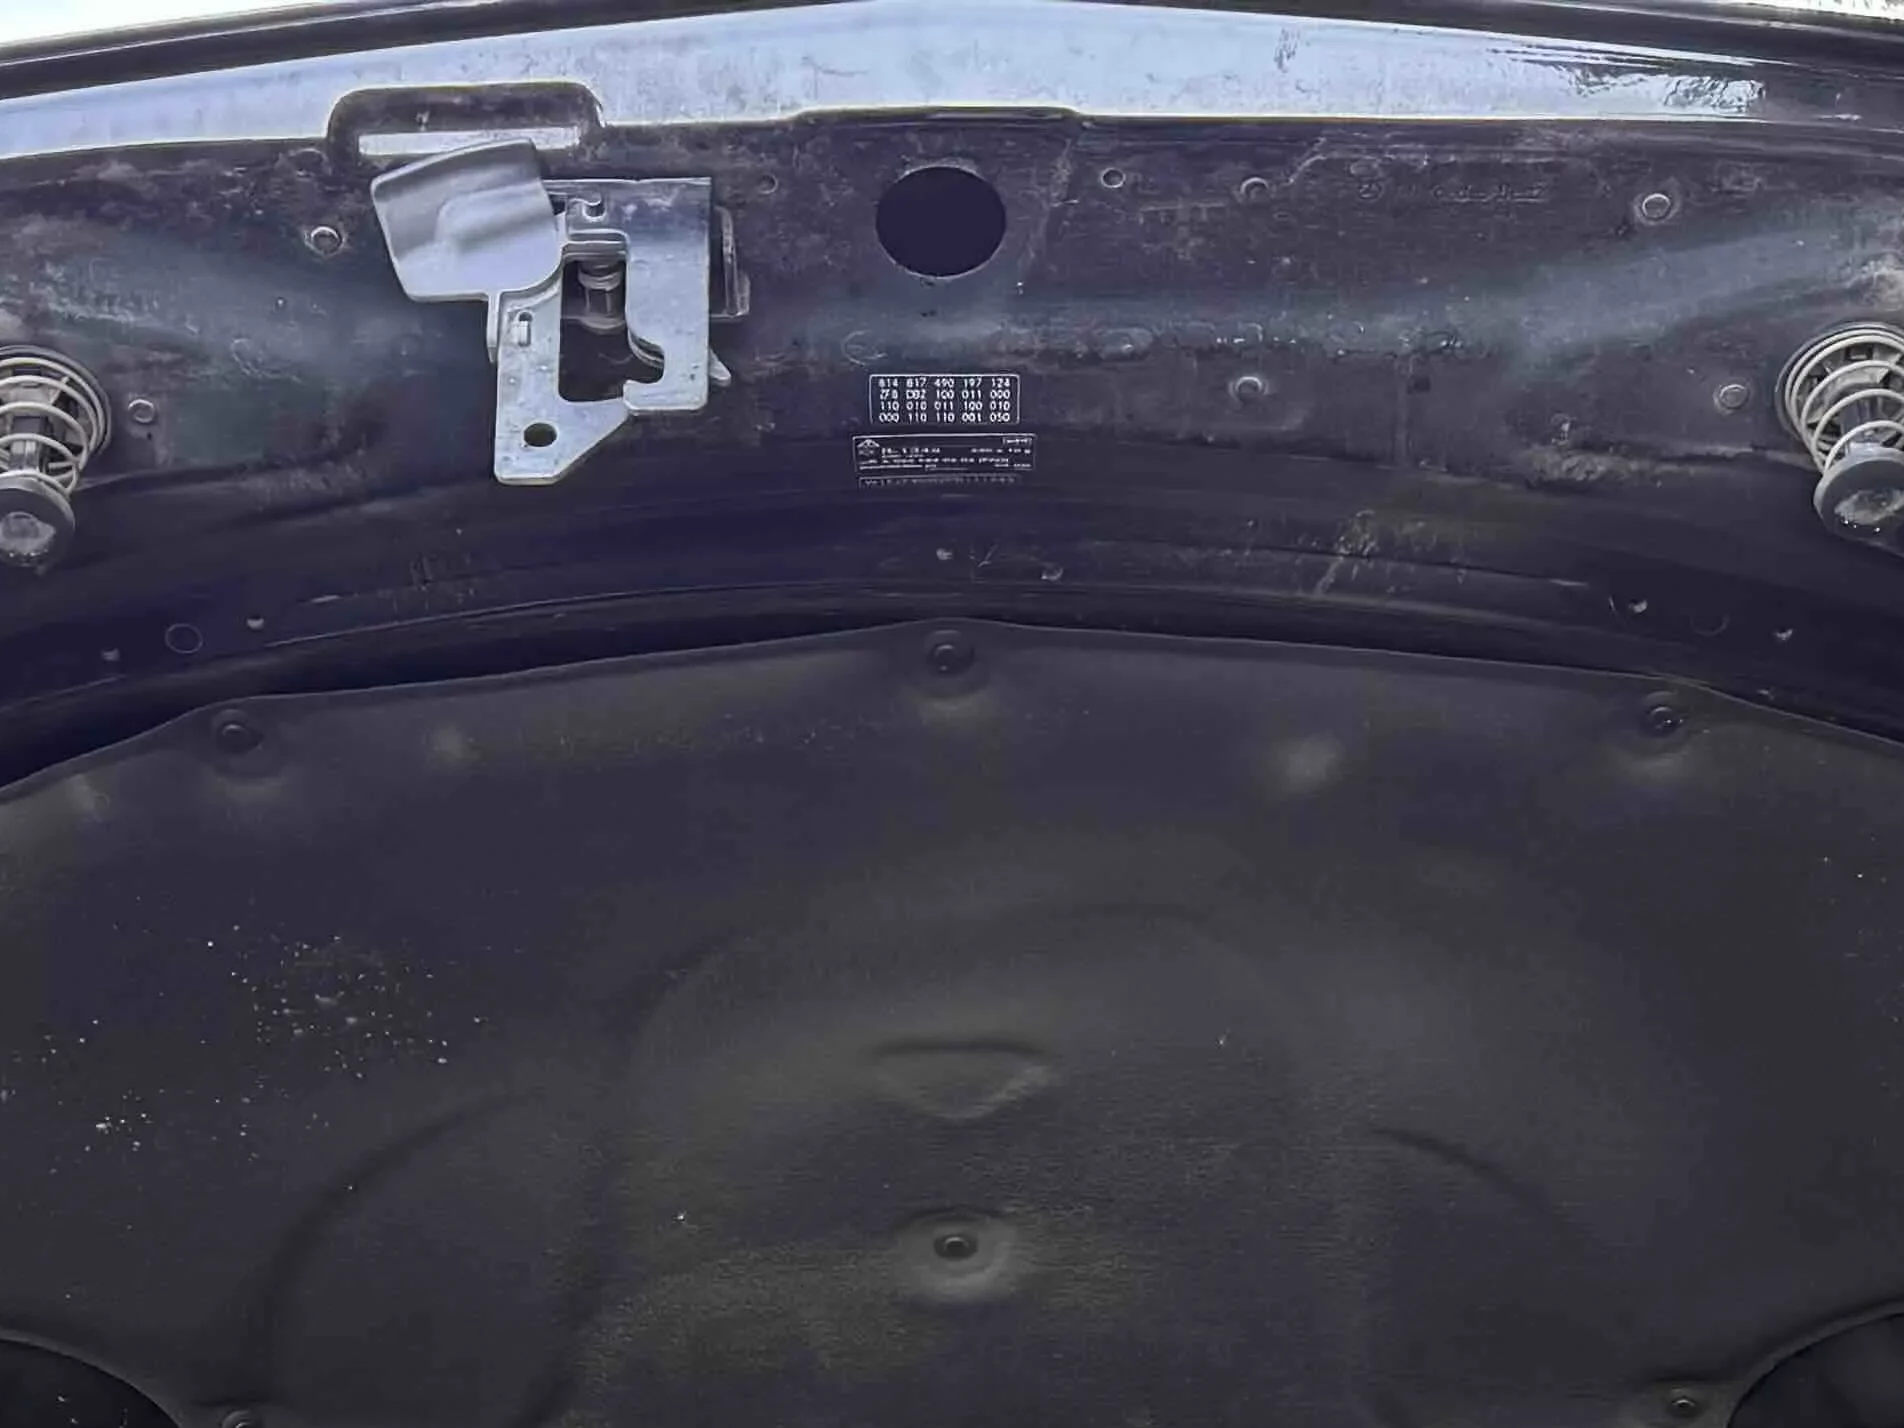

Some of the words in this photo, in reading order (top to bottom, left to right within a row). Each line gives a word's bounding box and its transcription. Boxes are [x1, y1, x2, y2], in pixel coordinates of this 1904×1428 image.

[962, 389, 982, 400] 011
[879, 401, 899, 411] 110
[906, 401, 927, 411] 010
[934, 401, 954, 411] 011
[962, 401, 982, 411] 100
[990, 401, 1010, 411] 010
[906, 412, 927, 423] 110
[934, 412, 954, 423] 110
[962, 412, 982, 423] 001
